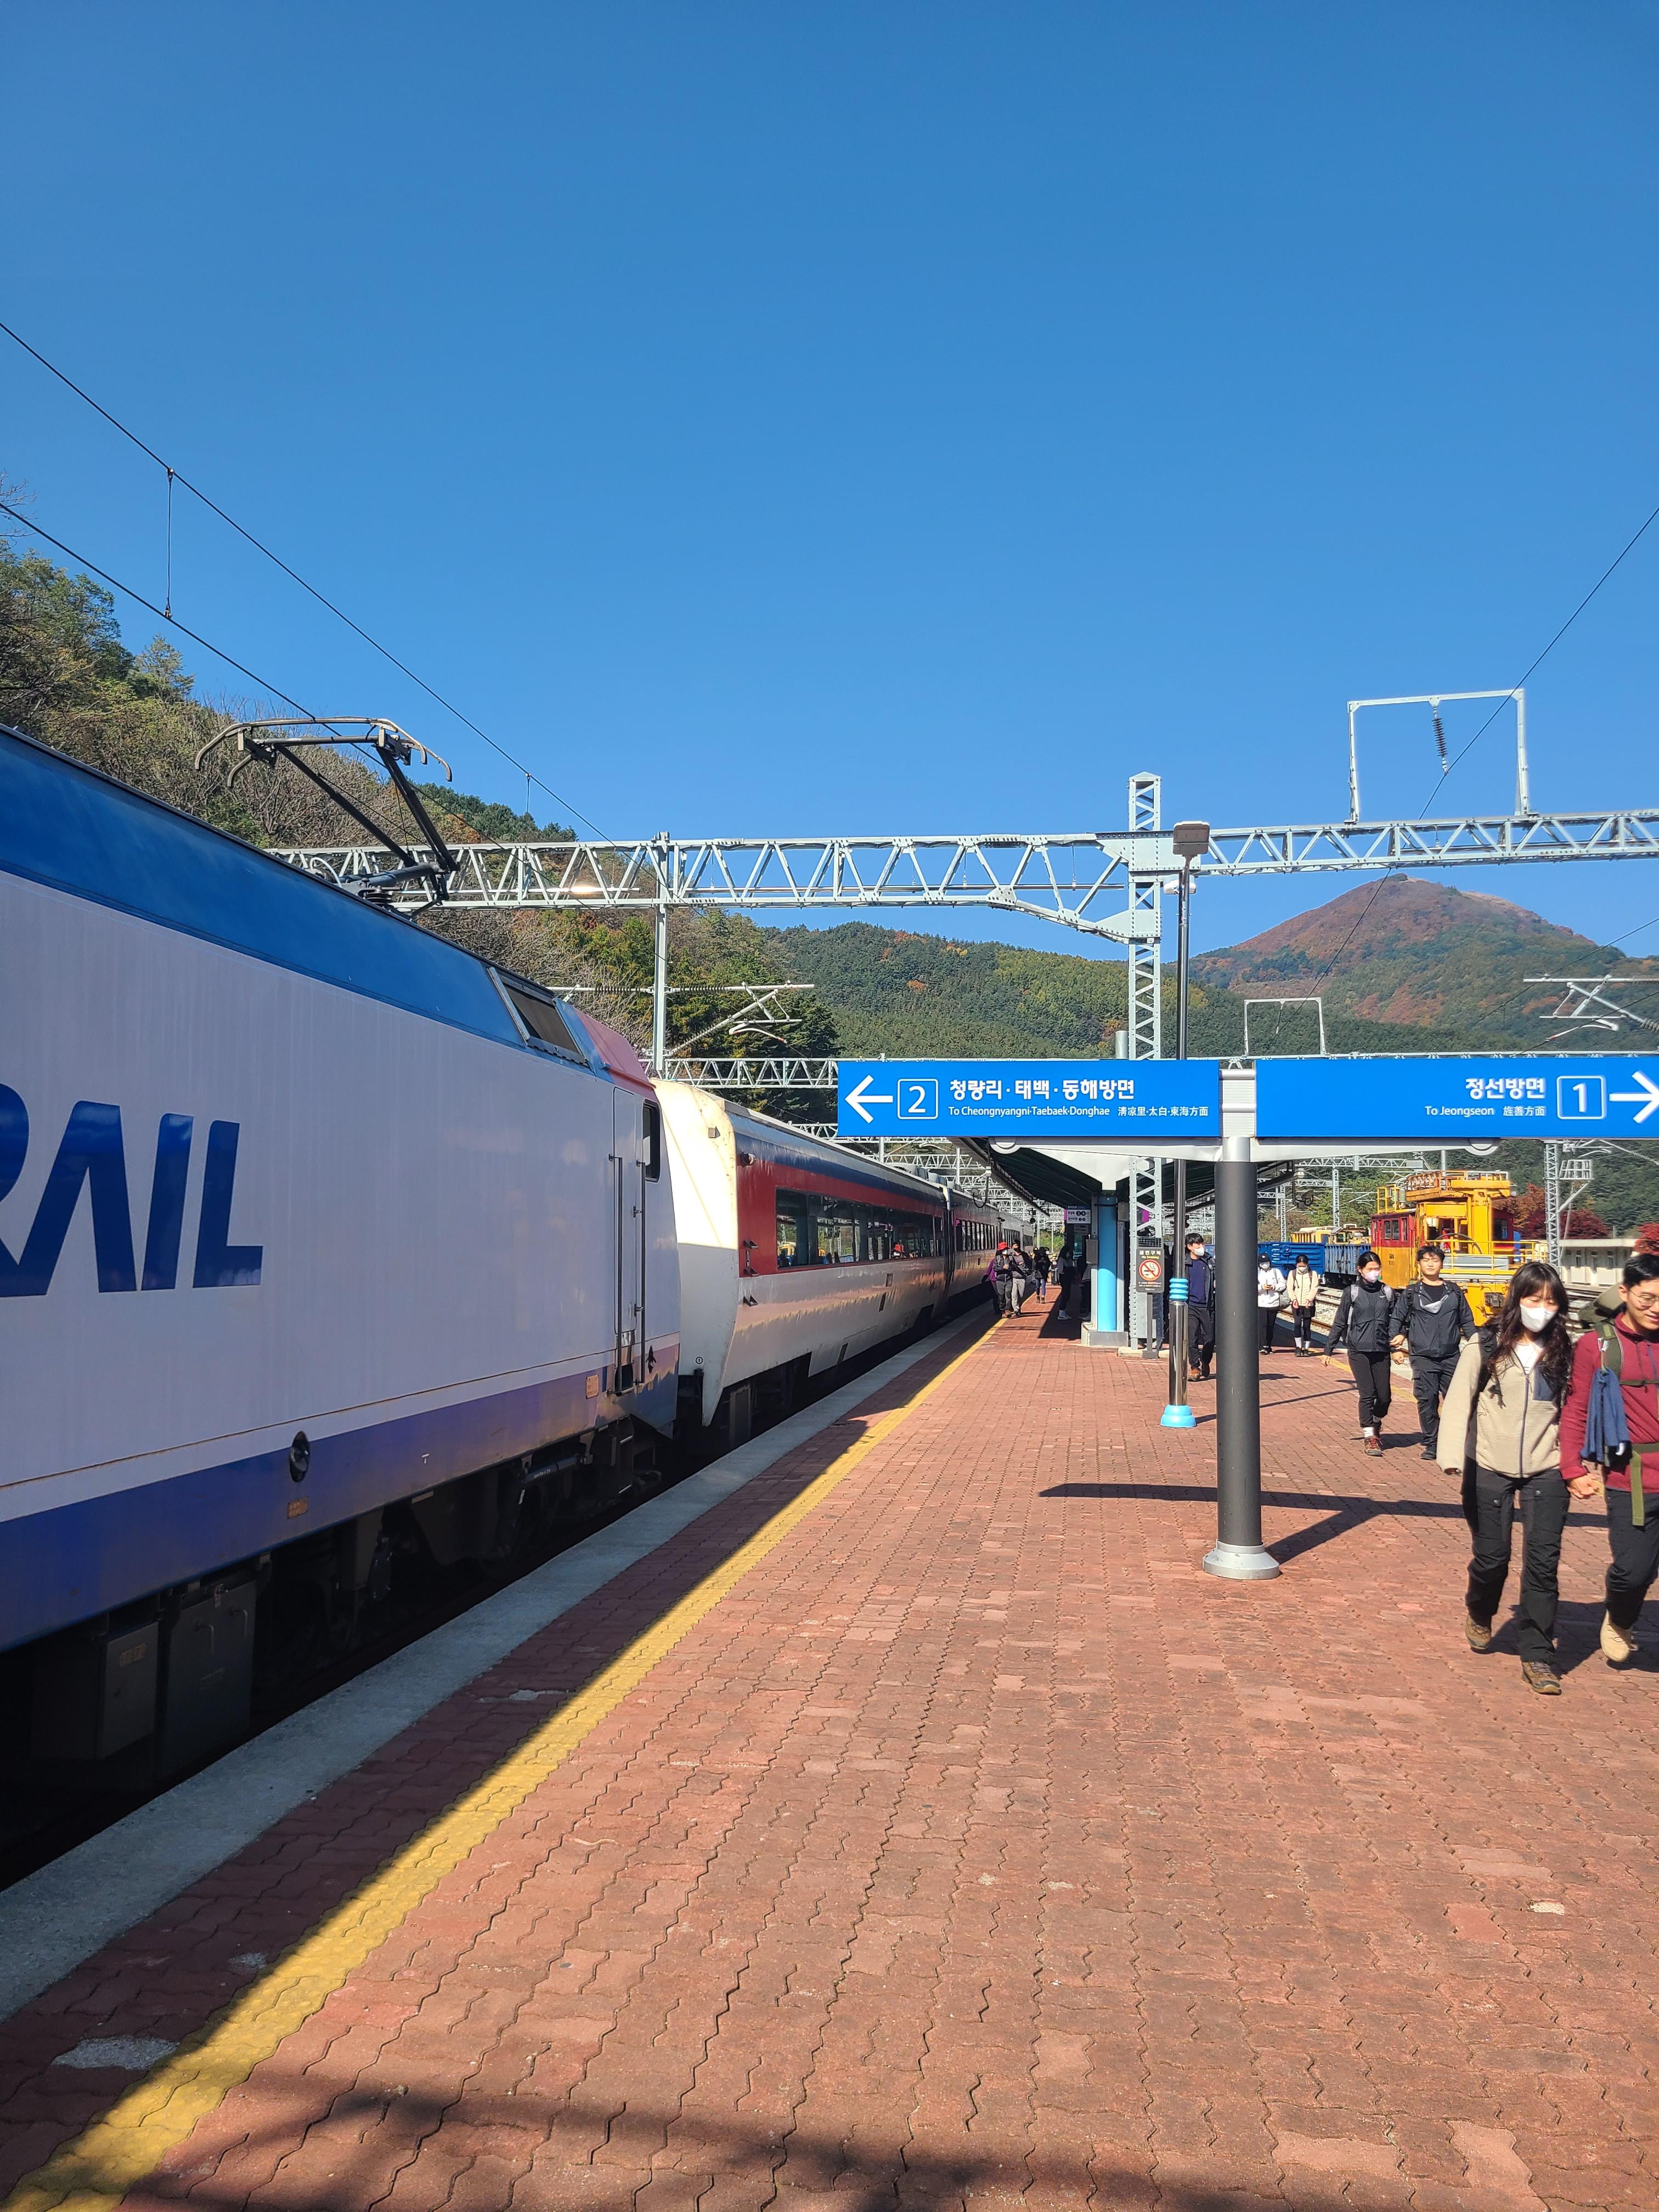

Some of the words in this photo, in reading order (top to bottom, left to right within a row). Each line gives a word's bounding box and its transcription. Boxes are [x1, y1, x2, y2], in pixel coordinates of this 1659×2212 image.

[908, 1085, 926, 1113] 2
[950, 1079, 1002, 1101] 청량리
[1015, 1080, 1049, 1099] 태백
[1062, 1079, 1134, 1101] 동해방면
[1465, 1077, 1546, 1100] 정선방면
[1572, 1084, 1587, 1113] 1
[948, 1106, 960, 1115] To
[1425, 1105, 1438, 1115] To
[1440, 1106, 1494, 1118] Jeongseon
[0, 1083, 263, 1297] AIL
